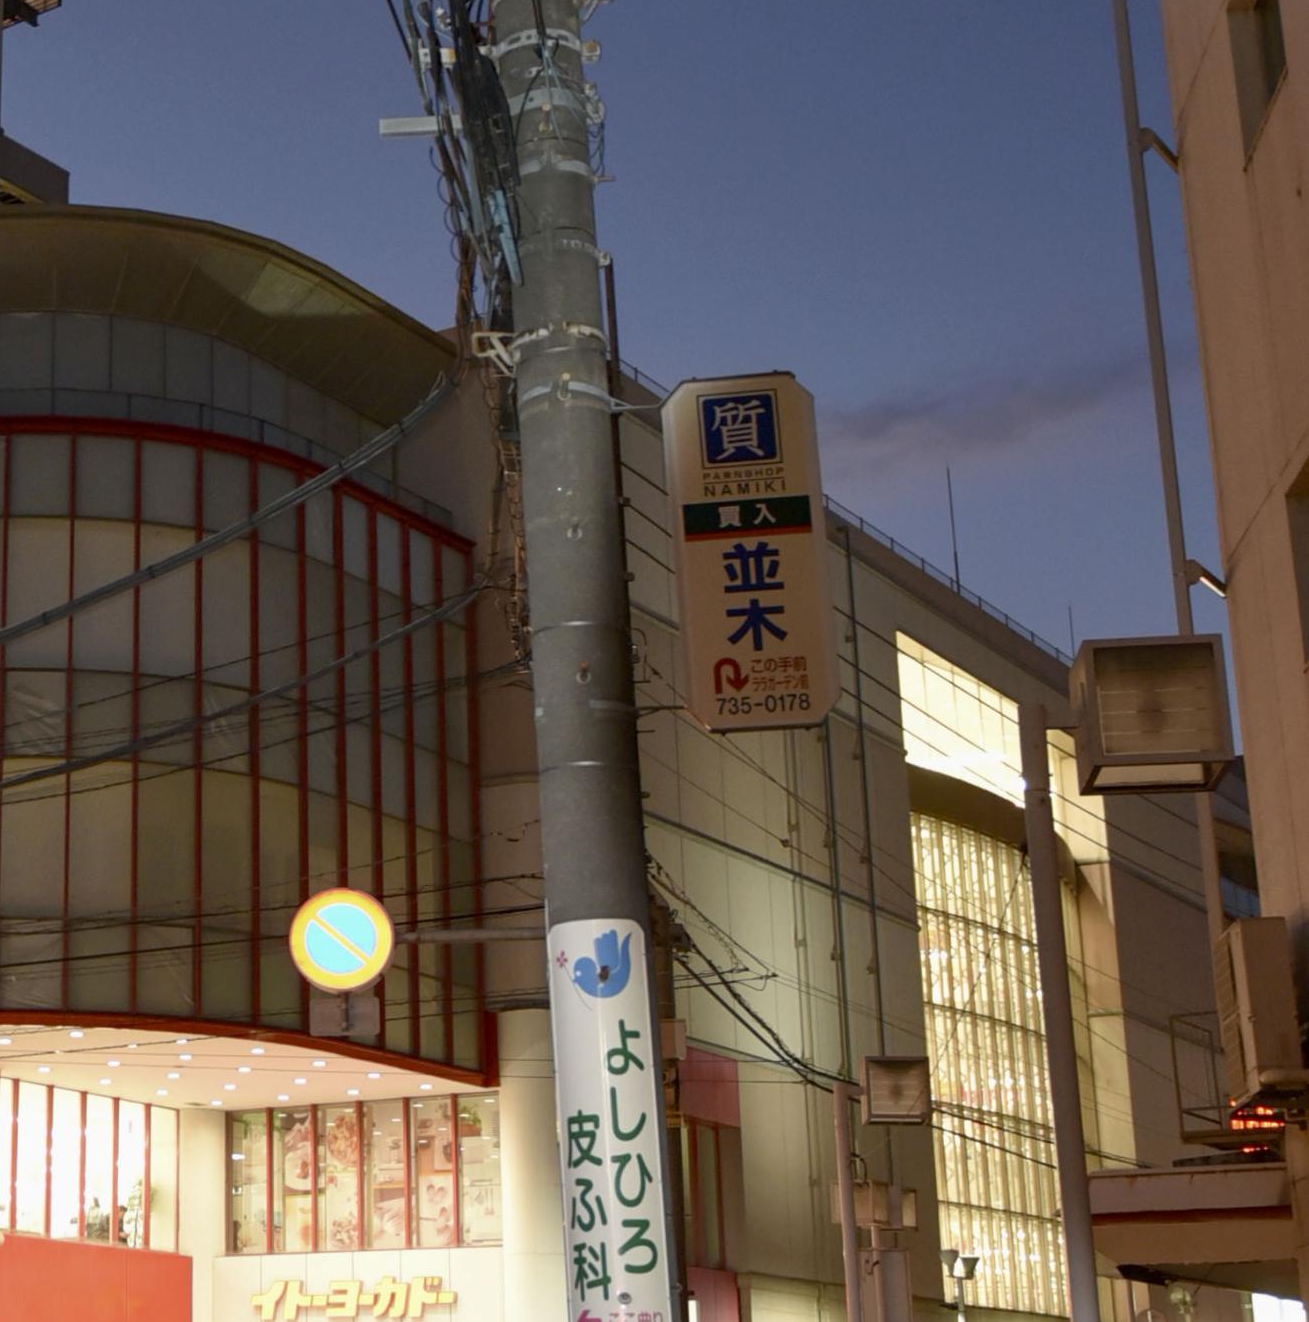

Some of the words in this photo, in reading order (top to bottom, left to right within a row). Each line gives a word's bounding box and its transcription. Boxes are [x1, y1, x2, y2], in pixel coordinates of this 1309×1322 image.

[711, 399, 767, 461] 質
[702, 466, 785, 481] PAWNSHOP
[703, 479, 787, 498] NAMIKI
[722, 541, 788, 652] 並木
[750, 656, 807, 674] この手前
[716, 693, 811, 715] 735-0178
[607, 1019, 659, 1275] よしひろ
[566, 1108, 612, 1303] 皮ふ科
[252, 1276, 457, 1320] イトーヨーカドー
